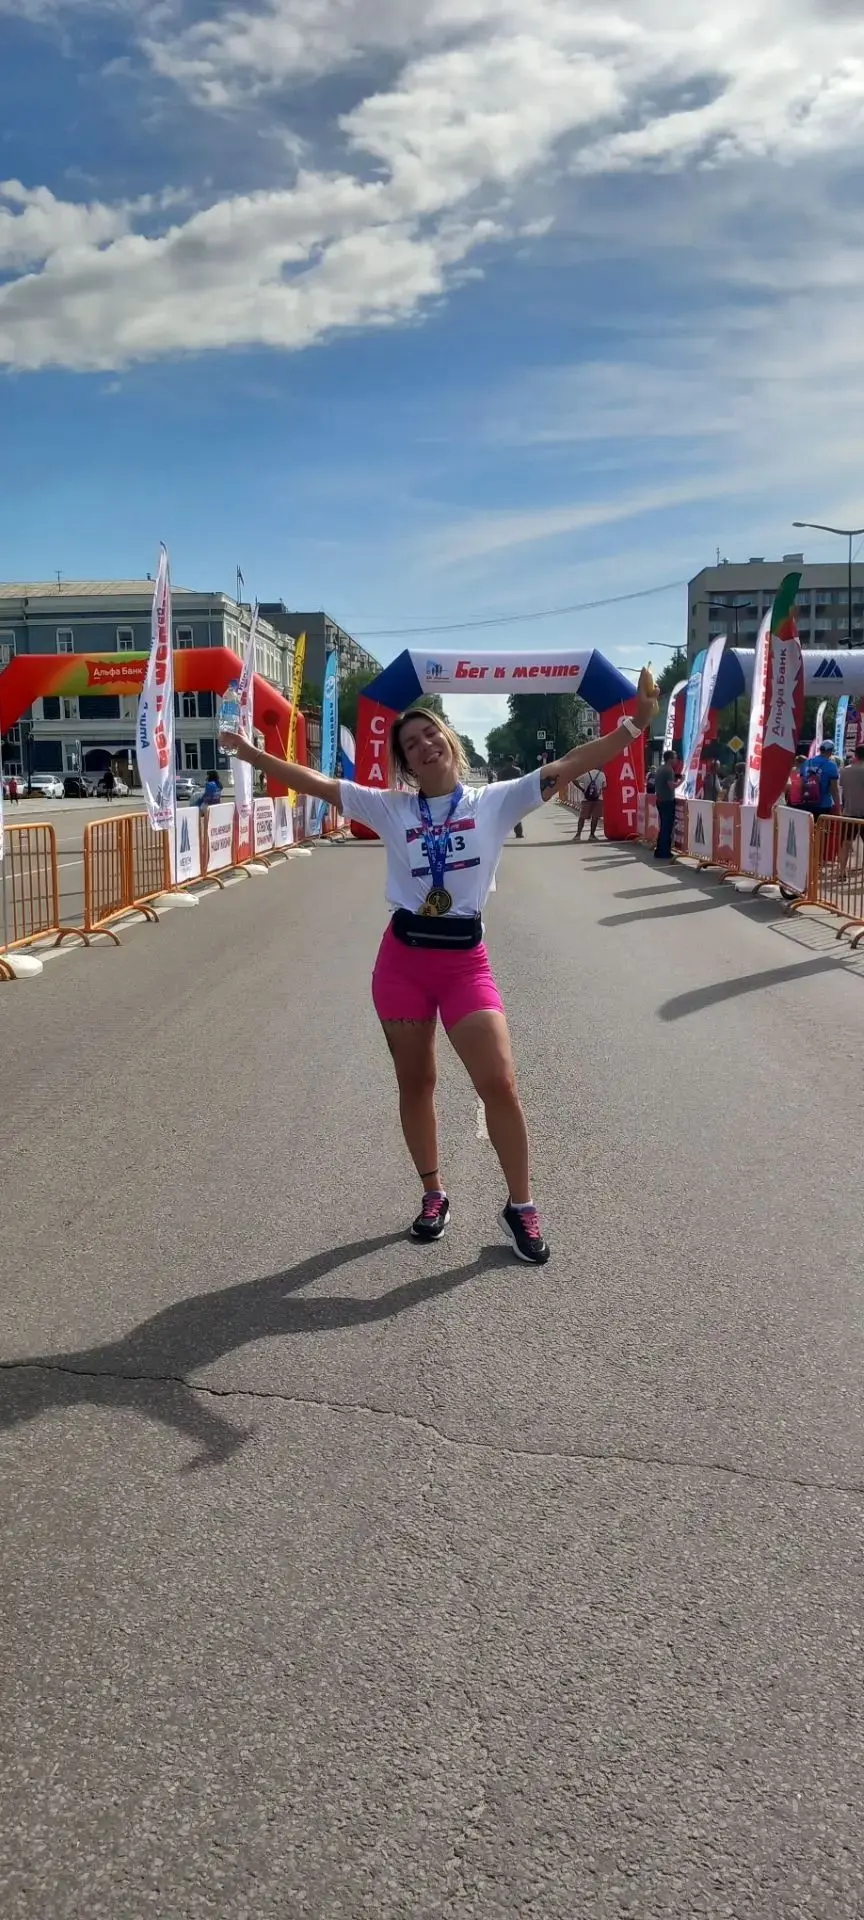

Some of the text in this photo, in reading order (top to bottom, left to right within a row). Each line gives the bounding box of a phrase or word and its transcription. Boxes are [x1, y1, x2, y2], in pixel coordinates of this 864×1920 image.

[93, 666, 143, 678] Альфа Банк
[455, 660, 489, 679] Бег
[493, 667, 506, 679] к
[512, 664, 580, 678] мечте
[777, 647, 787, 684] Банк
[772, 688, 786, 738] Альфа
[421, 836, 466, 857] 513
